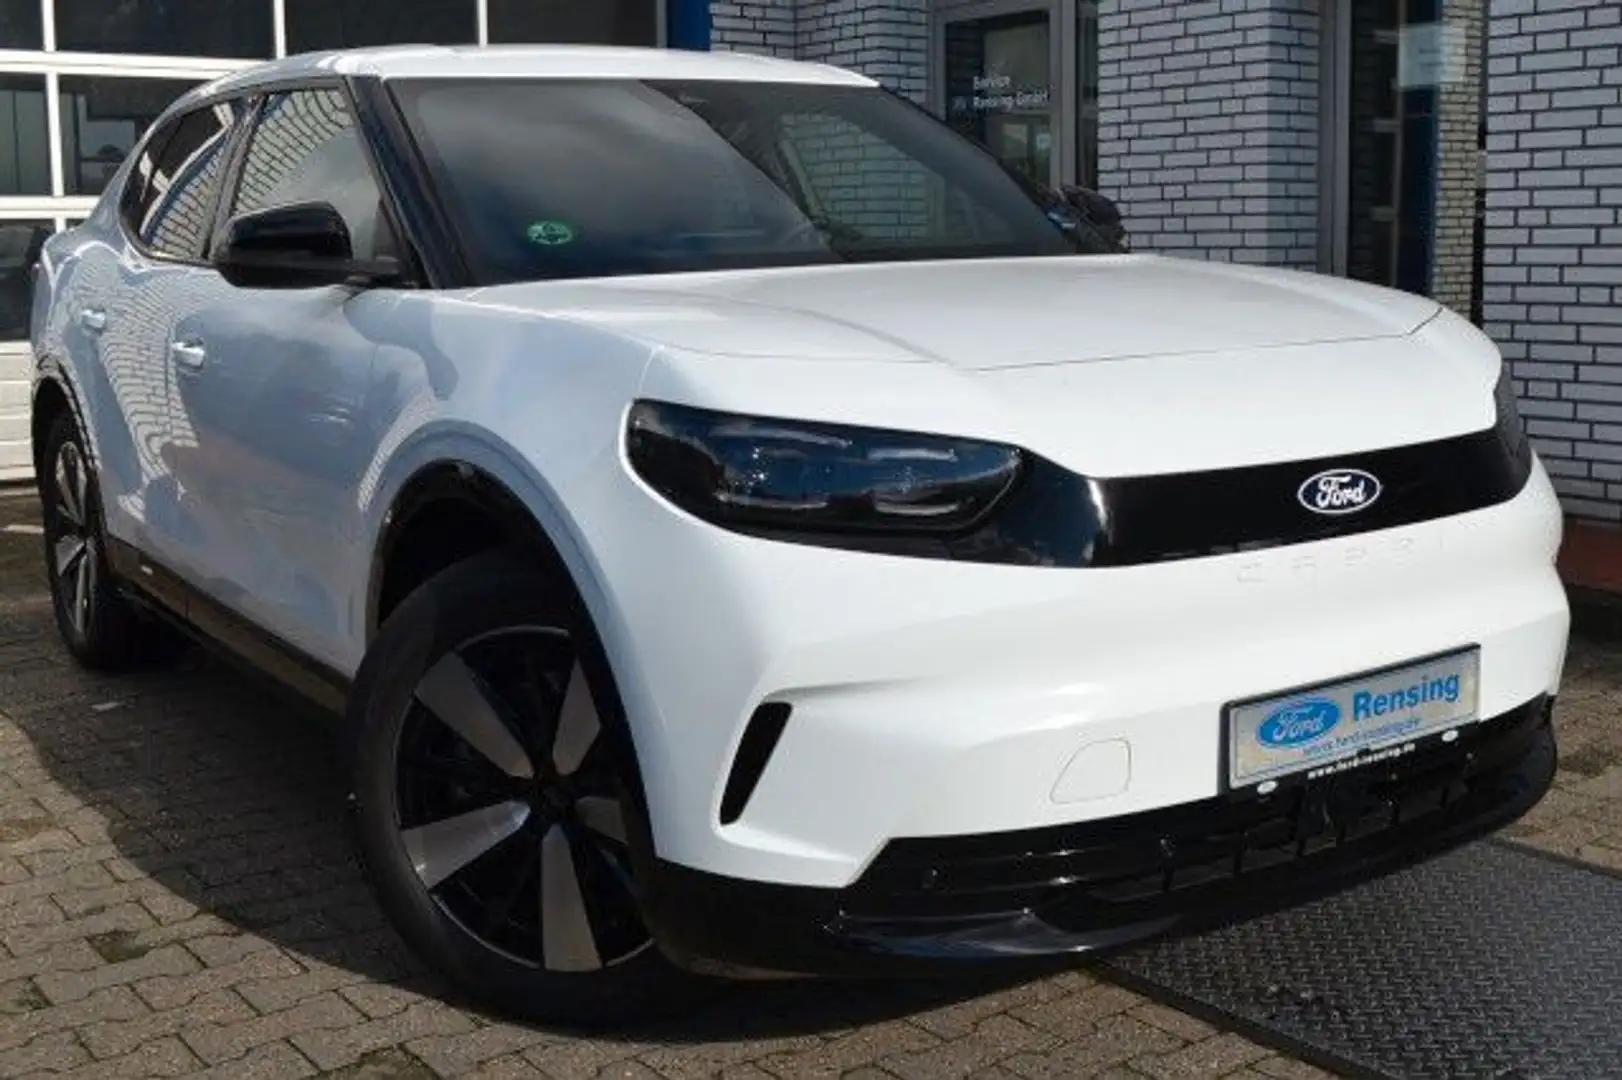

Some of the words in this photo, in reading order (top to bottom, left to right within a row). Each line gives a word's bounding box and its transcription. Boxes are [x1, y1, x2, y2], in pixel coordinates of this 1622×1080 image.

[1314, 473, 1368, 509] Ford
[1271, 700, 1328, 742] Ford
[1352, 673, 1461, 722] Rensing
